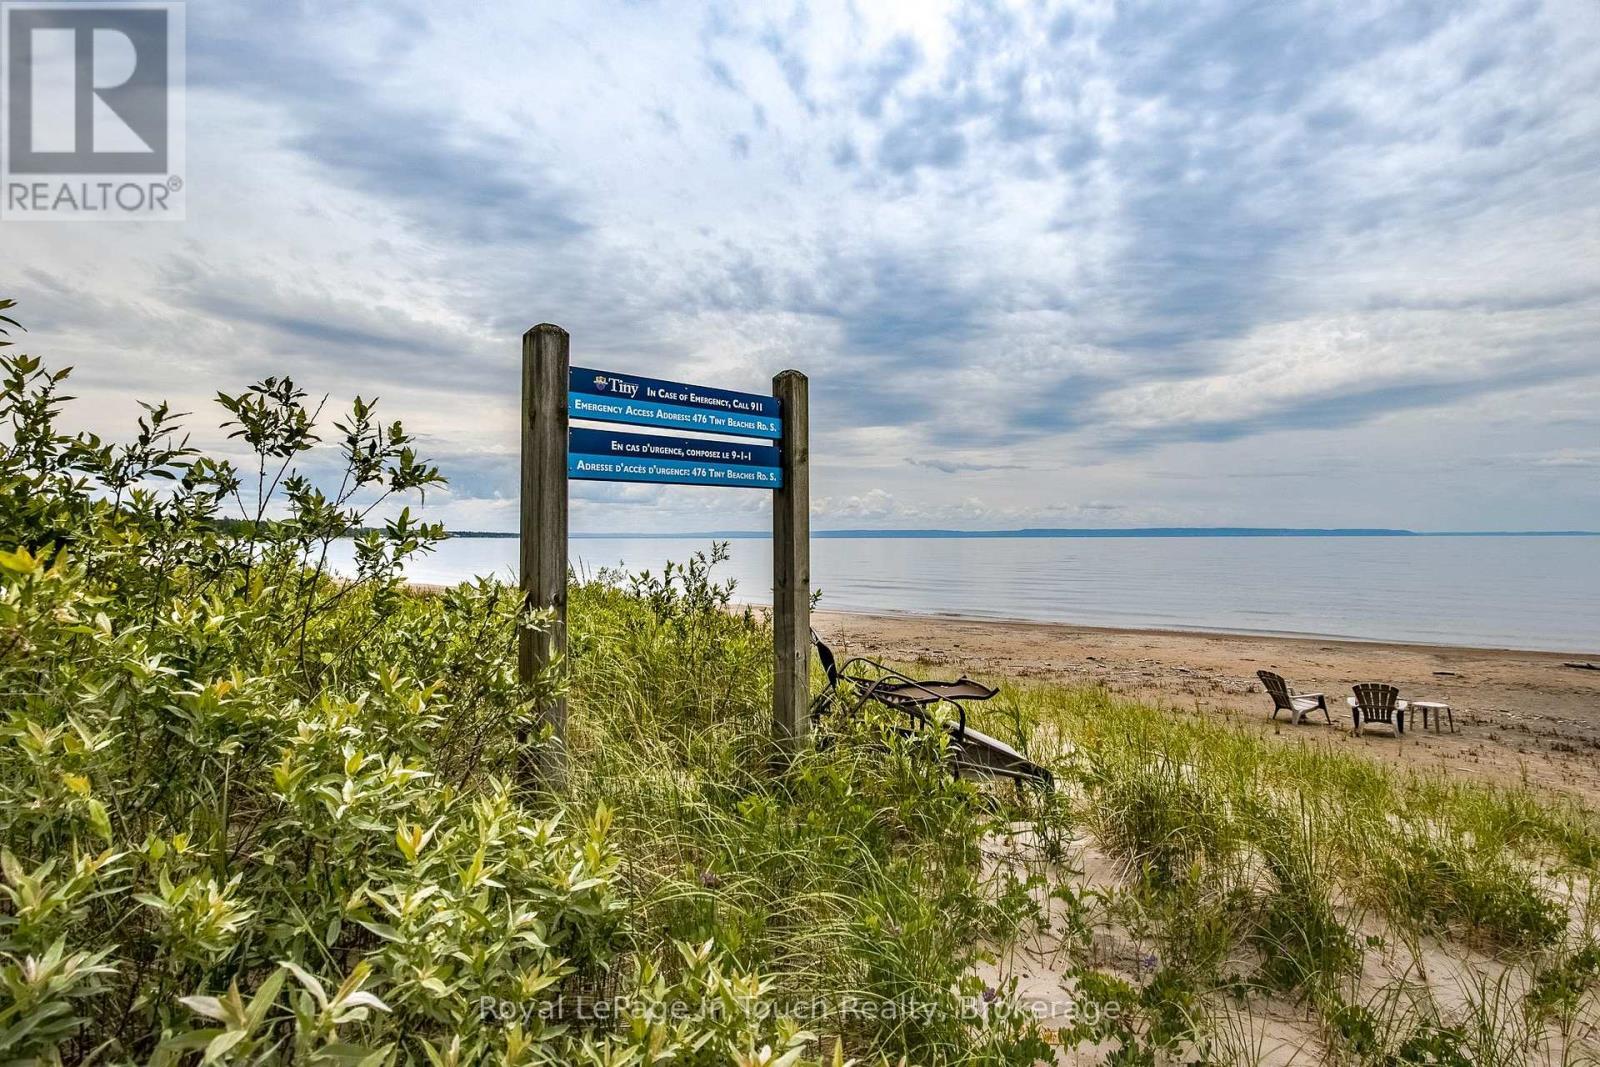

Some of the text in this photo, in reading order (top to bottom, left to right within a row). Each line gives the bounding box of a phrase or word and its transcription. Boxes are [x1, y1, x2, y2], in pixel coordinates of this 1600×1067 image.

[608, 378, 639, 398] Tiny
[647, 387, 656, 397] IN
[658, 388, 677, 400] CASE
[690, 393, 731, 409] EMERGENCY,
[732, 399, 749, 410] CALL
[750, 402, 763, 412] 911
[574, 399, 777, 432] EMERGENCY ACCESS ADDRESS: 476 TINY BEACHES RD. S.
[611, 440, 624, 451] EN
[625, 444, 640, 452] CAS
[642, 443, 685, 457] D'URGENCE,
[686, 449, 720, 459] COMPOSEZ
[731, 451, 752, 461] 9-1-1
[576, 460, 613, 472] ADRESSE
[648, 465, 690, 477] D'URGENCE:
[691, 468, 707, 477] 476
[708, 469, 725, 478] TINY
[727, 469, 755, 480] BEACHES
[756, 472, 768, 481] RD.
[769, 473, 777, 482] S.
